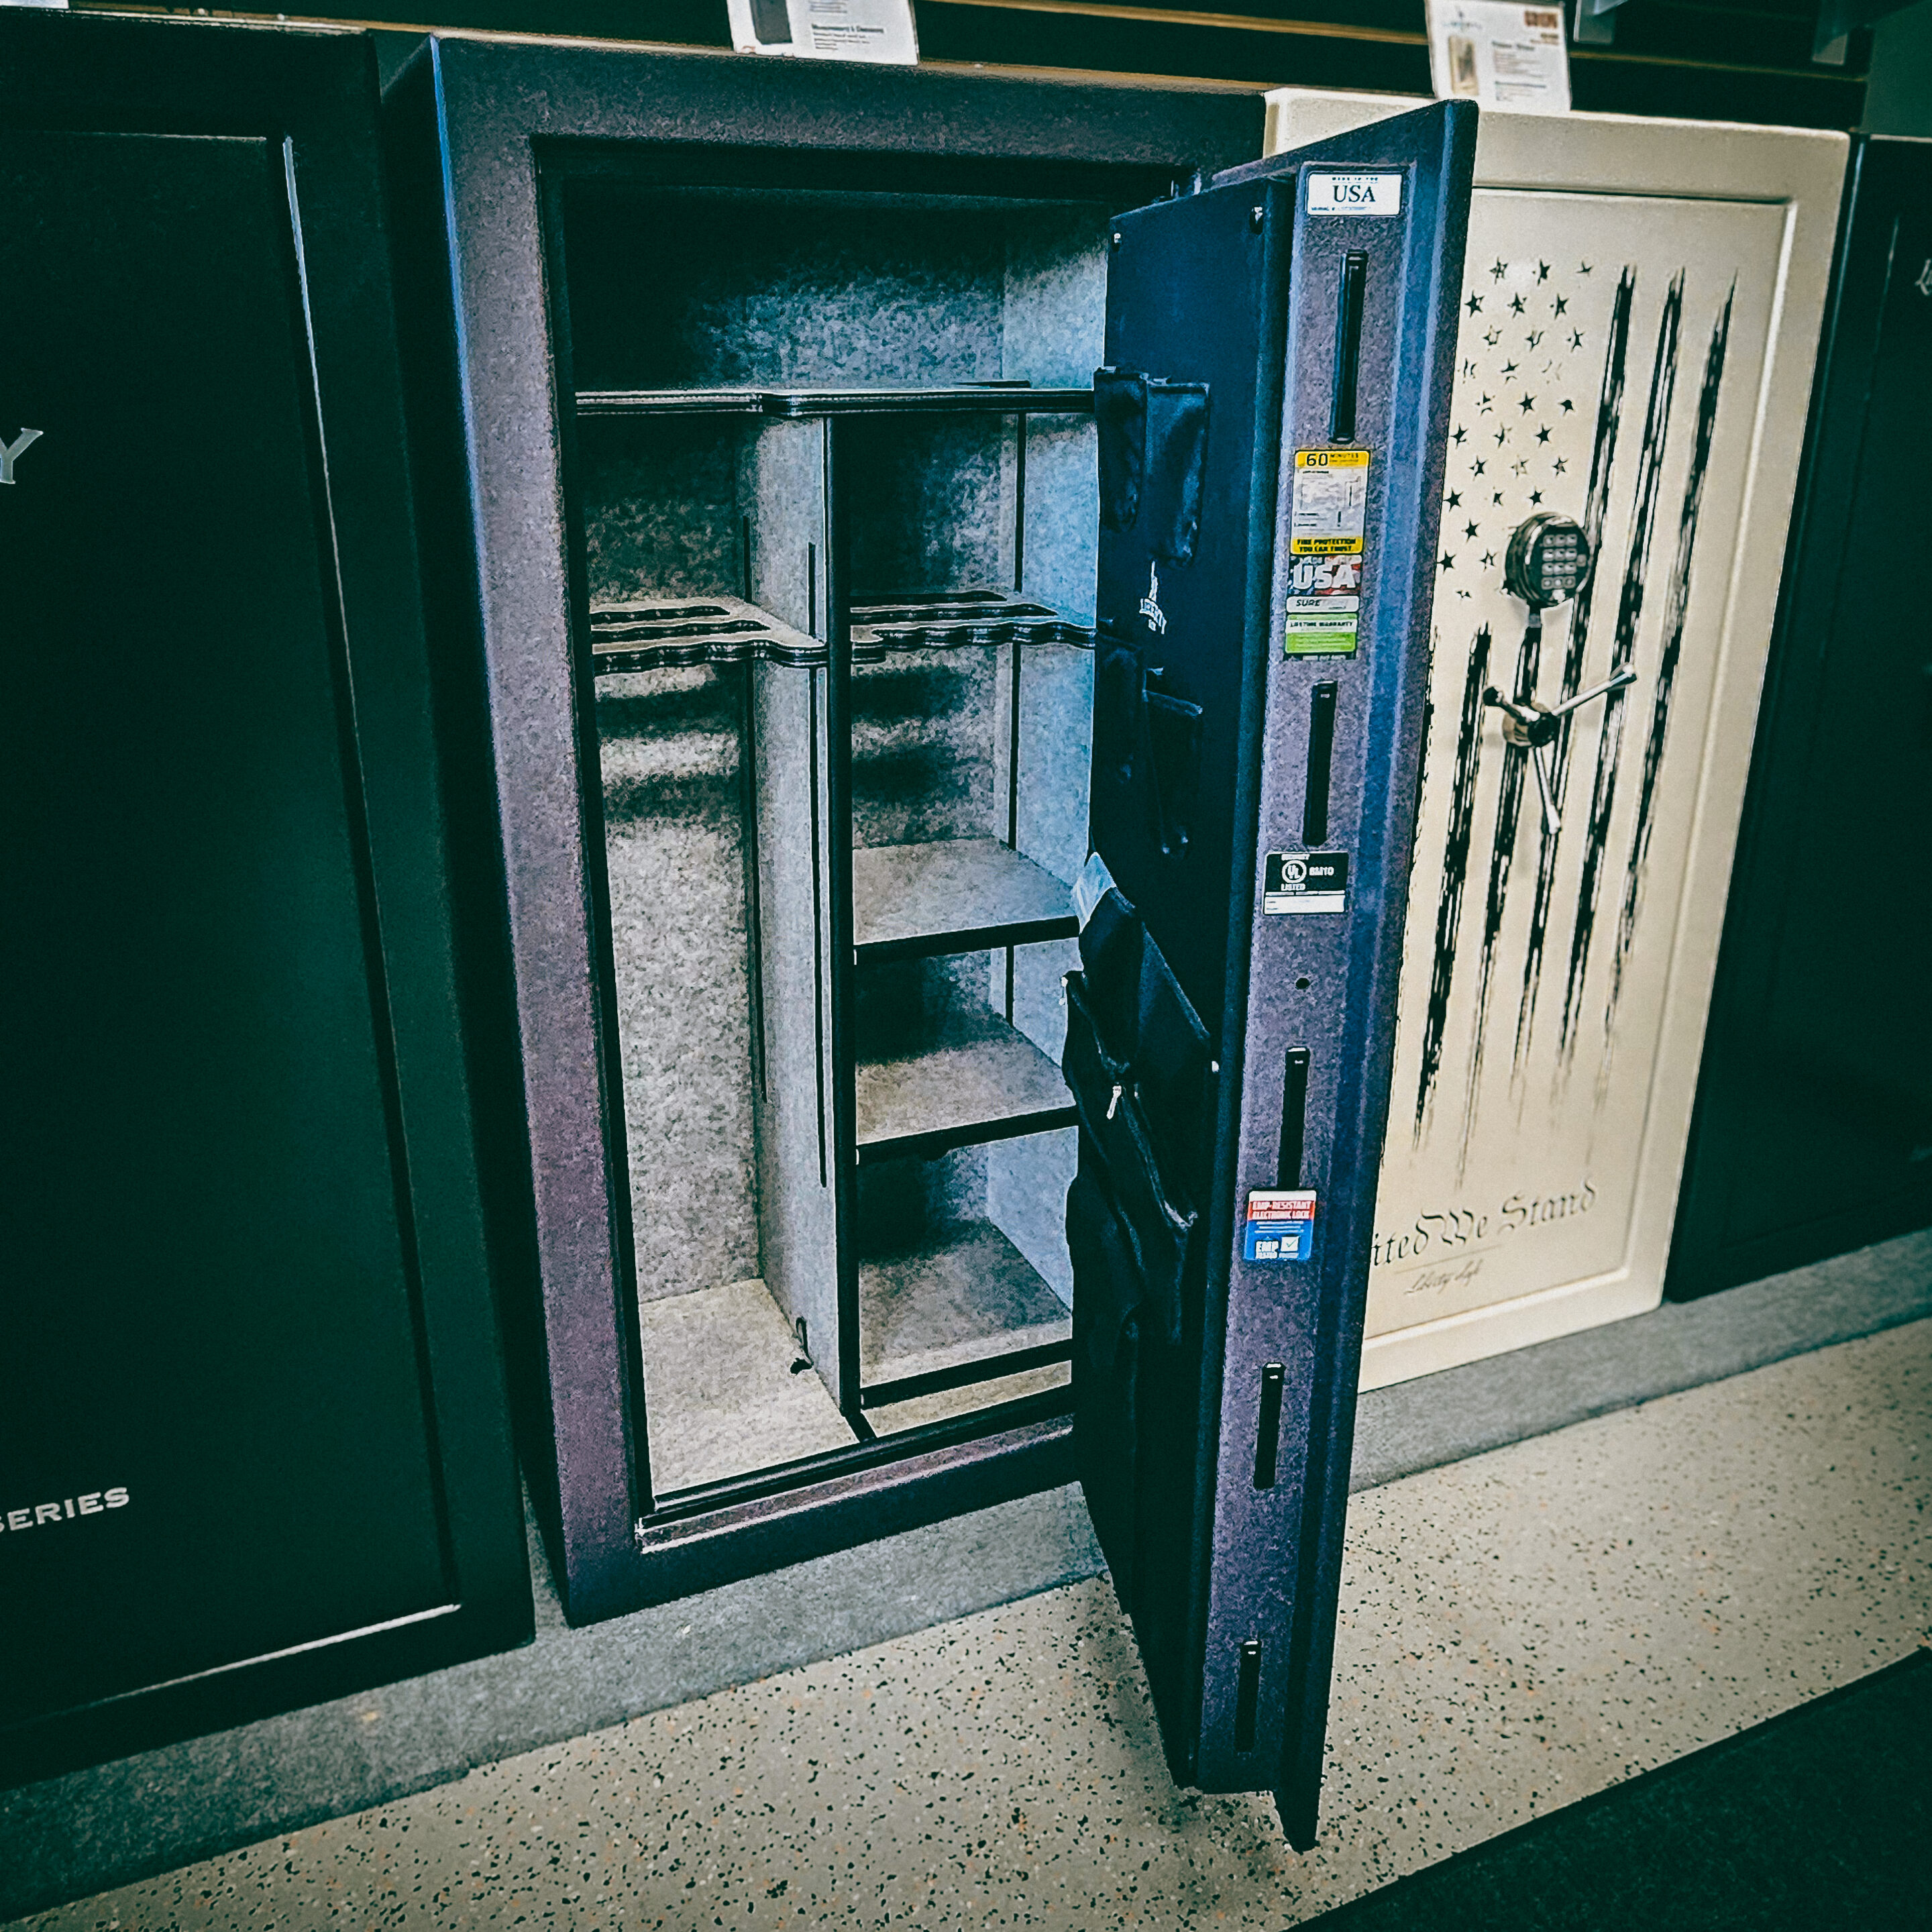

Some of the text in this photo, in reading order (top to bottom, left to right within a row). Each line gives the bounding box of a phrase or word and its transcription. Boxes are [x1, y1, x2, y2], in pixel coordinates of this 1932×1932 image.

[1332, 185, 1376, 203] USA
[1306, 453, 1328, 466] 60
[1293, 564, 1356, 589] USA
[1292, 1210, 1310, 1219] LOCK
[1421, 1208, 1487, 1245] We
[1499, 1177, 1596, 1234] Stand
[0, 1487, 129, 1533] ERIES
